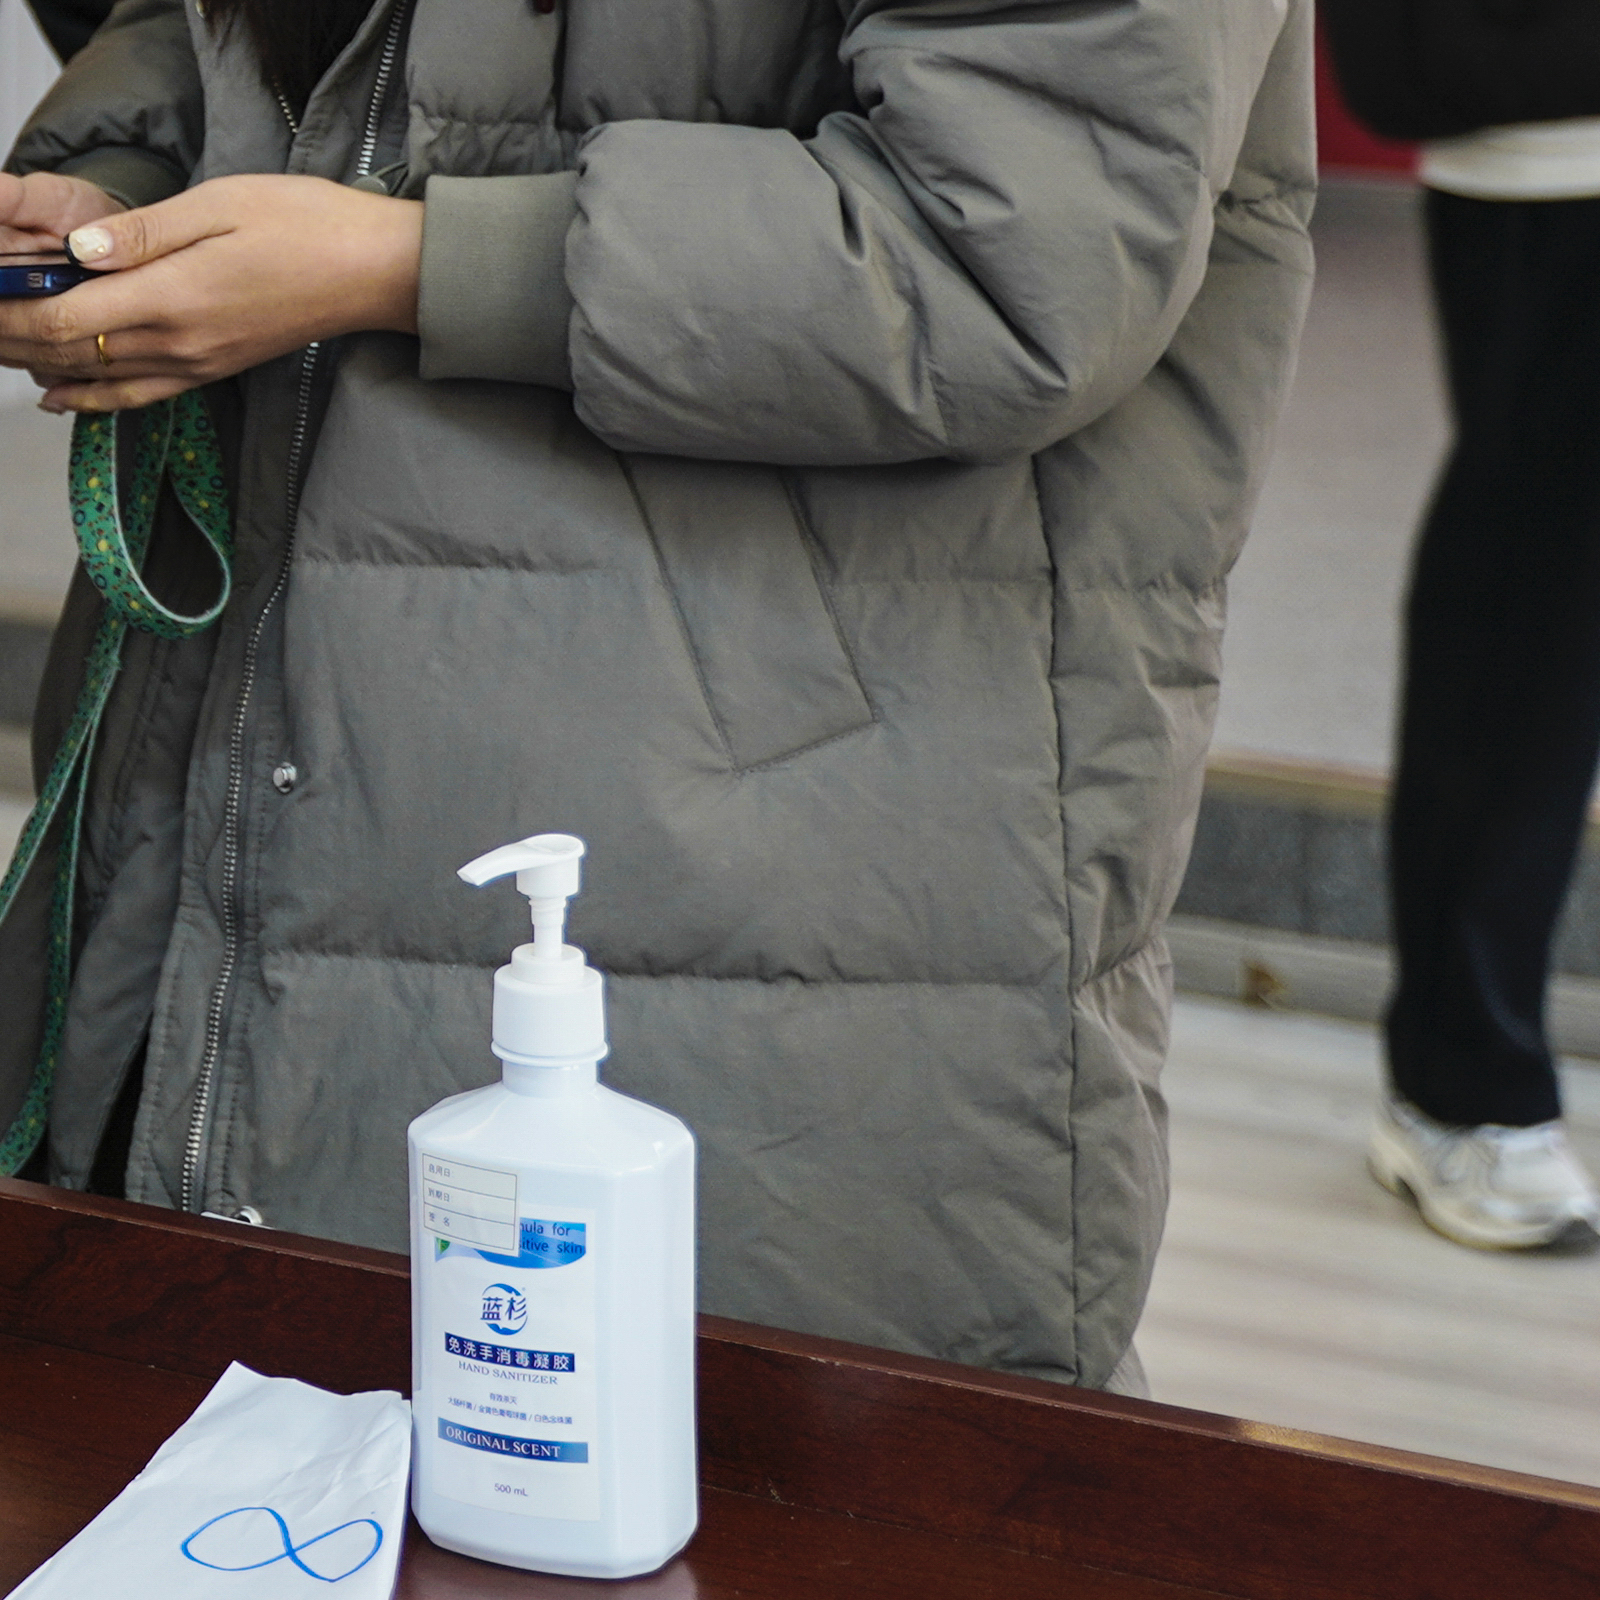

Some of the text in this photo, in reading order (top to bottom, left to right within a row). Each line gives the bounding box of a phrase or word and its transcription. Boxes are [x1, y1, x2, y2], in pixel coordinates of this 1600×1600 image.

[552, 1223, 570, 1236] for
[556, 1240, 582, 1254] skin
[480, 1296, 527, 1321] 蓝杉
[448, 1337, 569, 1370] 免洗手消毒凝胶
[458, 1360, 558, 1385] HAND SANITIZER
[445, 1425, 561, 1458] ORIGINAL SCENT
[494, 1483, 529, 1497] 500 mL
